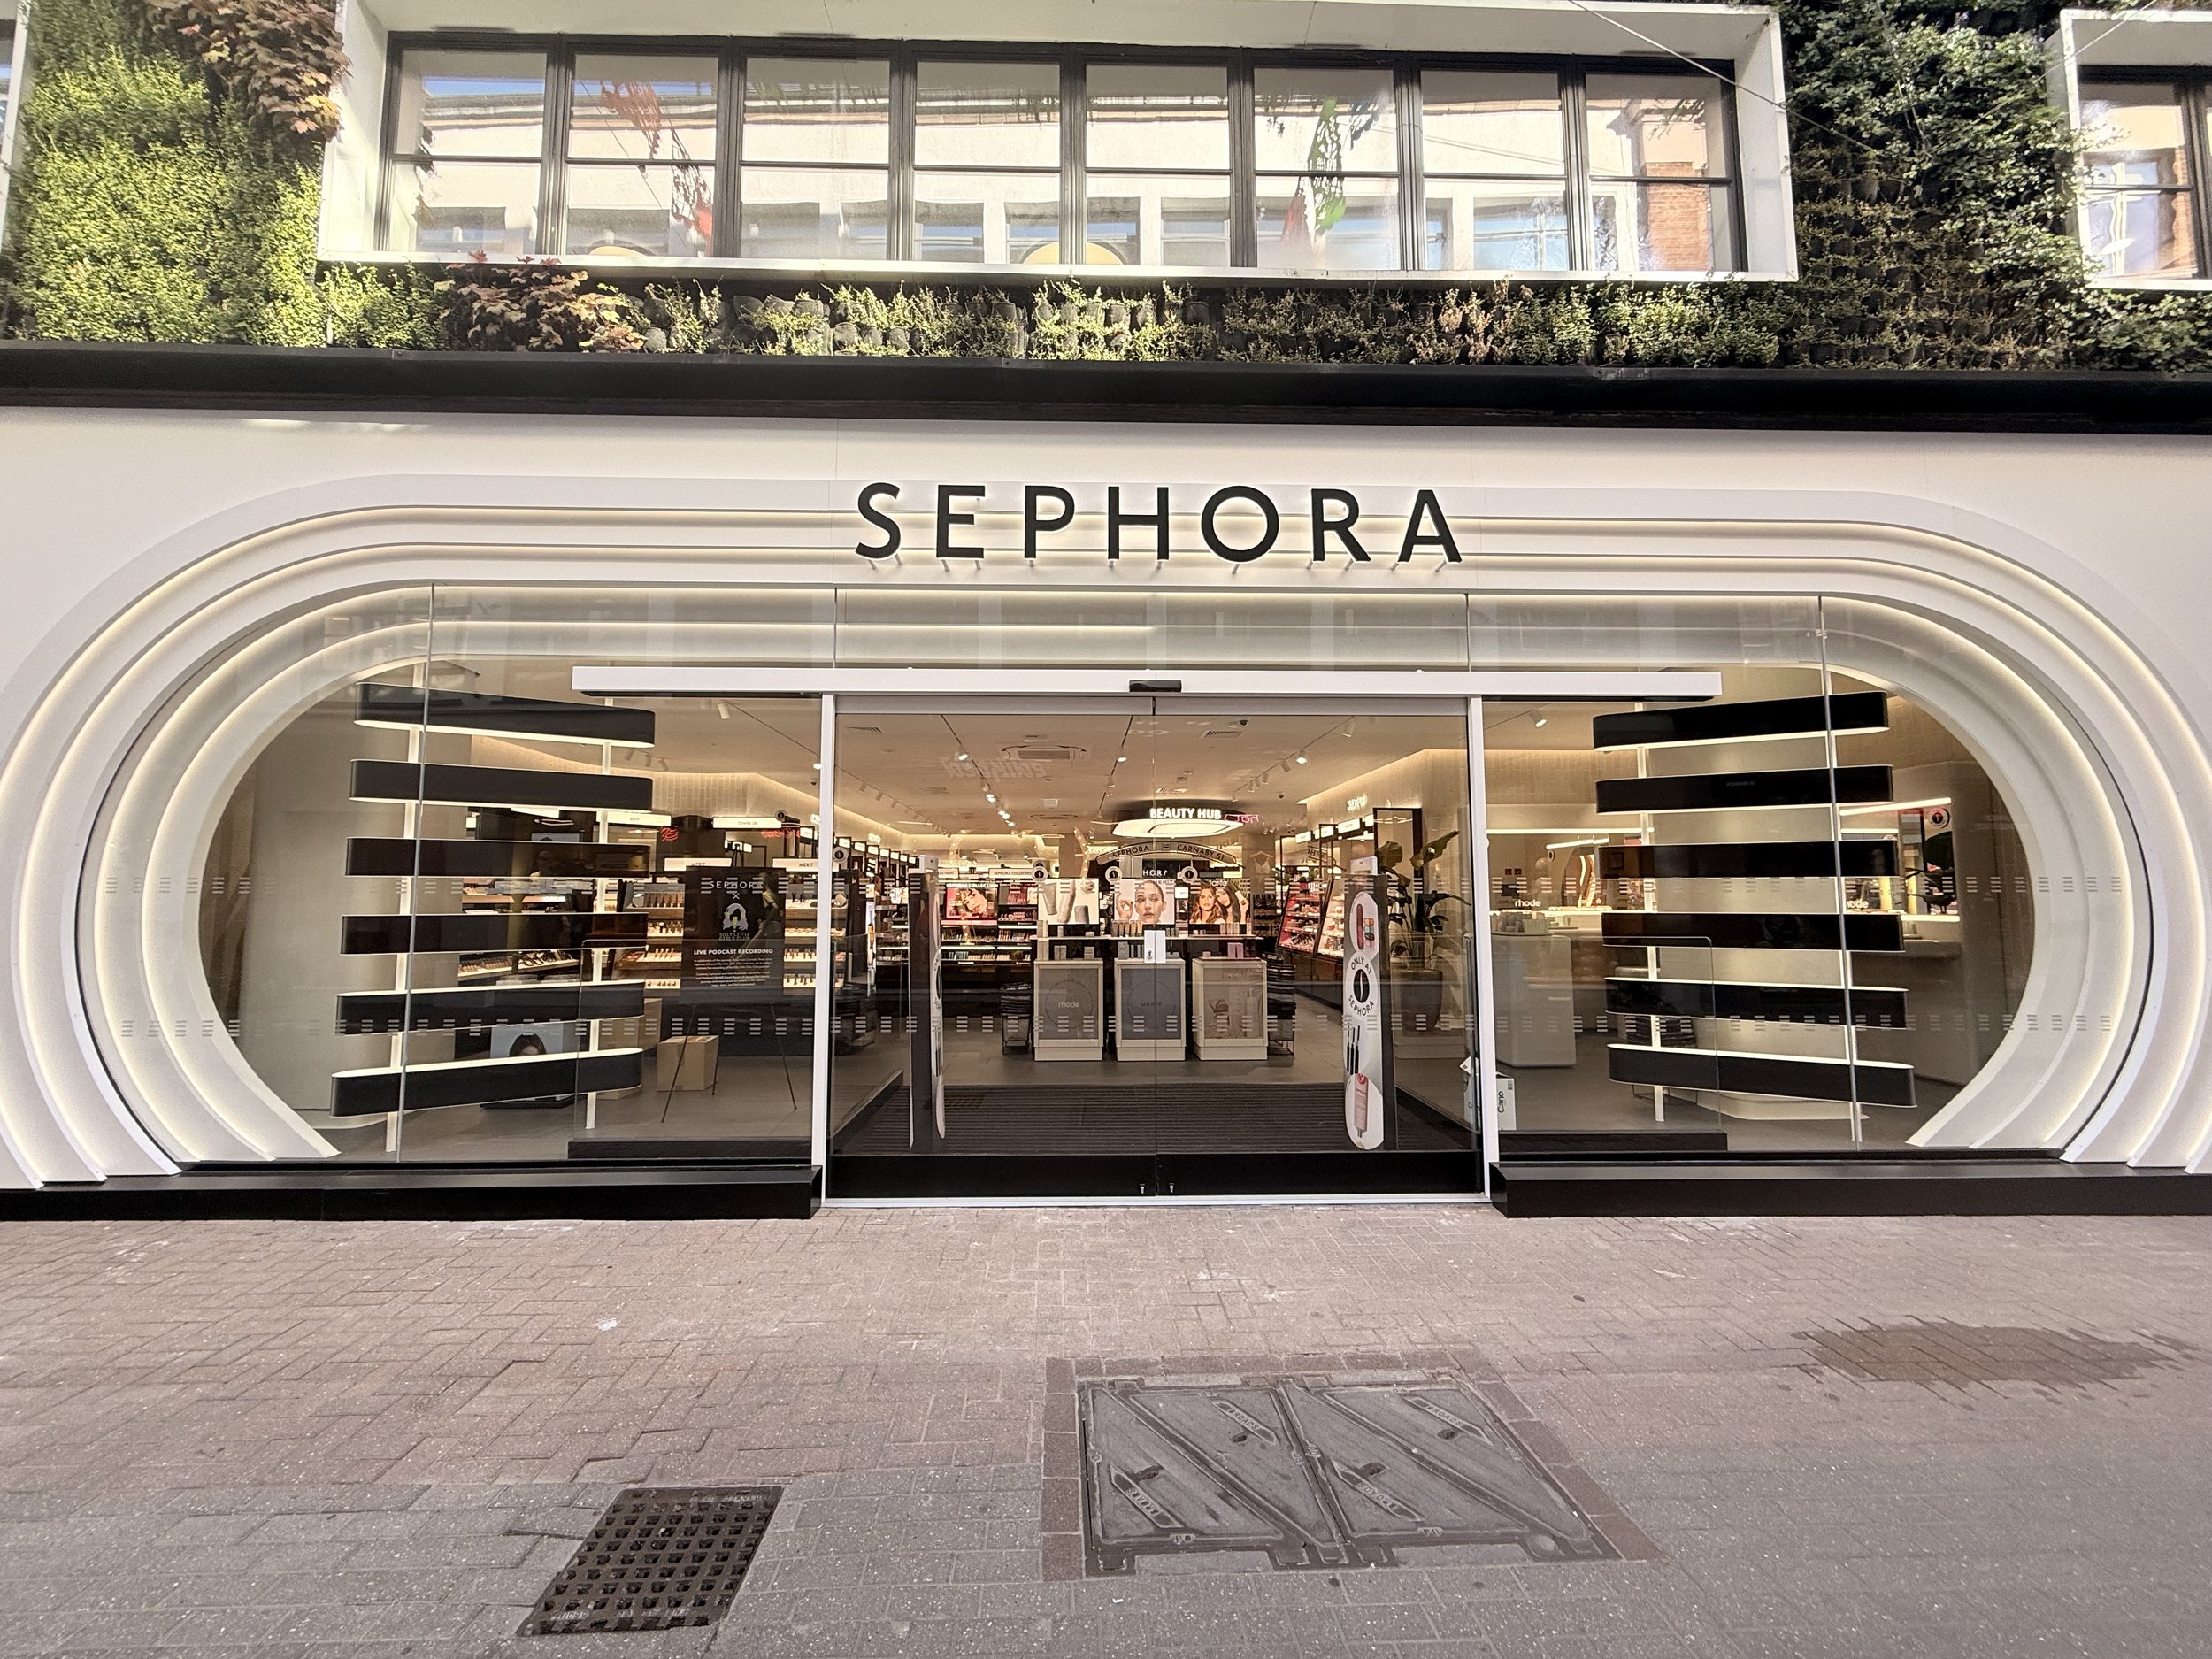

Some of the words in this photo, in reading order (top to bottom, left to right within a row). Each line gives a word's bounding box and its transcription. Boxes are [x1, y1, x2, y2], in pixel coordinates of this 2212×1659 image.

[855, 482, 1462, 563] SEPHORA
[1149, 808, 1195, 818] BEAUTY
[1198, 808, 1222, 819] HUB
[1113, 845, 1149, 857] SEPHORA
[1177, 844, 1214, 857] CARNABY
[710, 880, 764, 889] SEPHORA
[1351, 956, 1364, 971] ONLY
[1364, 964, 1372, 975] AT
[1348, 995, 1375, 1016] SEPHORA
[1228, 1408, 1260, 1431] BROADS
